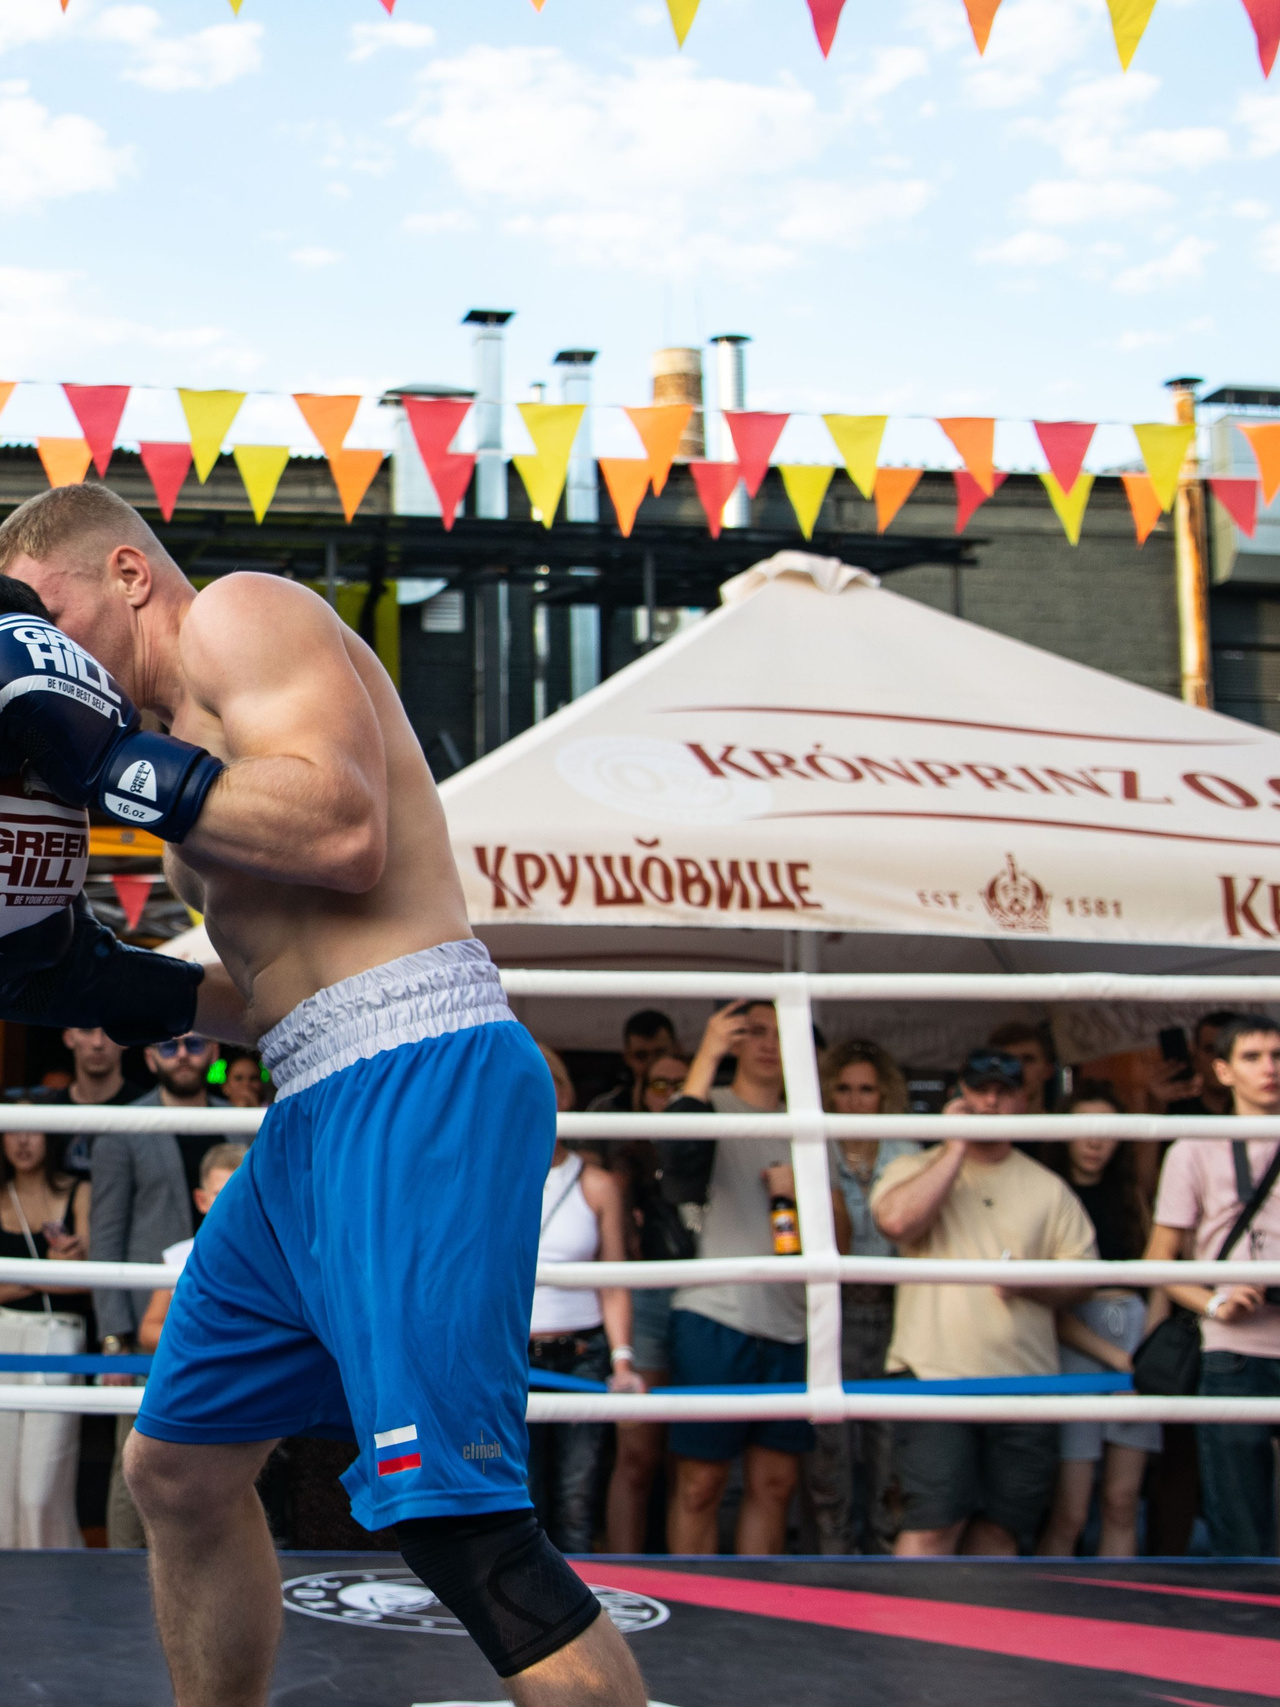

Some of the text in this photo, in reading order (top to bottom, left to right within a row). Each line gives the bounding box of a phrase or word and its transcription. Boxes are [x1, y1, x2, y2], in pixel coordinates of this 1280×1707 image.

[26, 644, 121, 704] HILL
[47, 678, 106, 711] BE YOUR BEST SELF
[130, 761, 147, 792] GREEN
[135, 768, 151, 793] HILL
[1065, 897, 1123, 918] 1581
